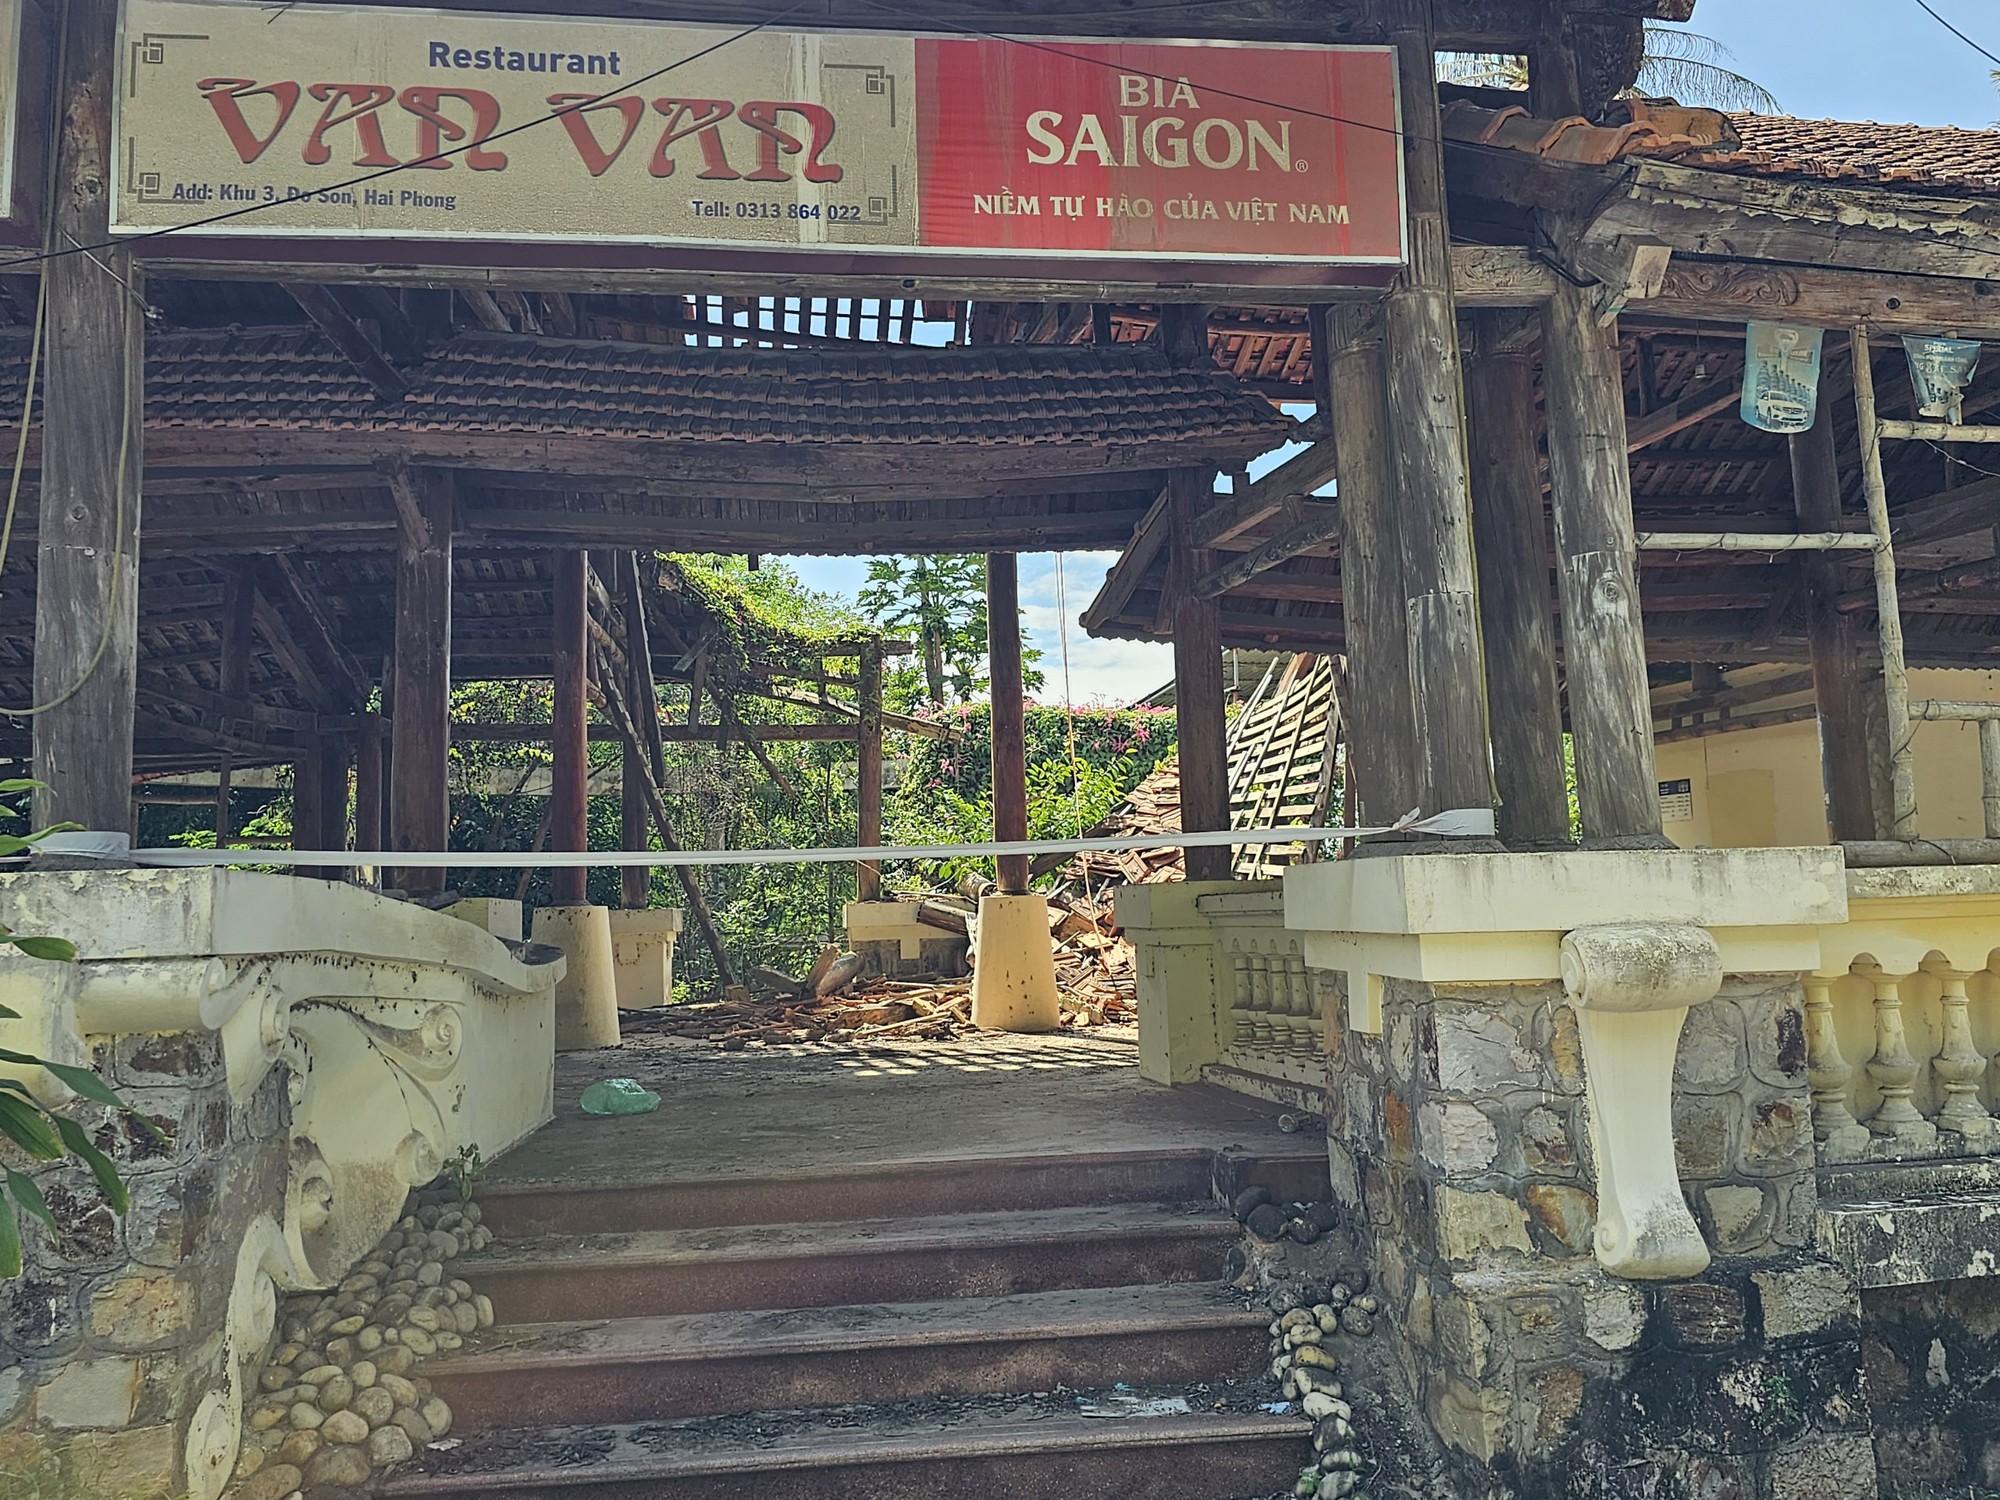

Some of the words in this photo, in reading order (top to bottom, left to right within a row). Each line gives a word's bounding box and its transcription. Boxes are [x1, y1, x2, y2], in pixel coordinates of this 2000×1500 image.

[429, 41, 621, 75] Restaurant
[1119, 75, 1200, 109] BIA
[196, 78, 508, 171] VAN
[545, 93, 844, 183] VAN
[1025, 110, 1291, 172] SAIGON
[172, 183, 213, 200] Add:
[220, 184, 256, 201] Khu
[318, 188, 357, 208] Son,
[364, 188, 394, 206] Hai
[400, 190, 457, 211] Phong
[692, 201, 730, 217] Tell:
[736, 202, 781, 218] 0313
[787, 204, 821, 219] 864
[827, 205, 861, 220] 022
[973, 186, 1041, 216] NIỀM
[1049, 195, 1086, 221] TỰ
[1096, 193, 1154, 218] HÀO
[1163, 193, 1220, 220] CỦA
[1224, 197, 1278, 226] VIỆT
[1288, 203, 1350, 225] NAM
